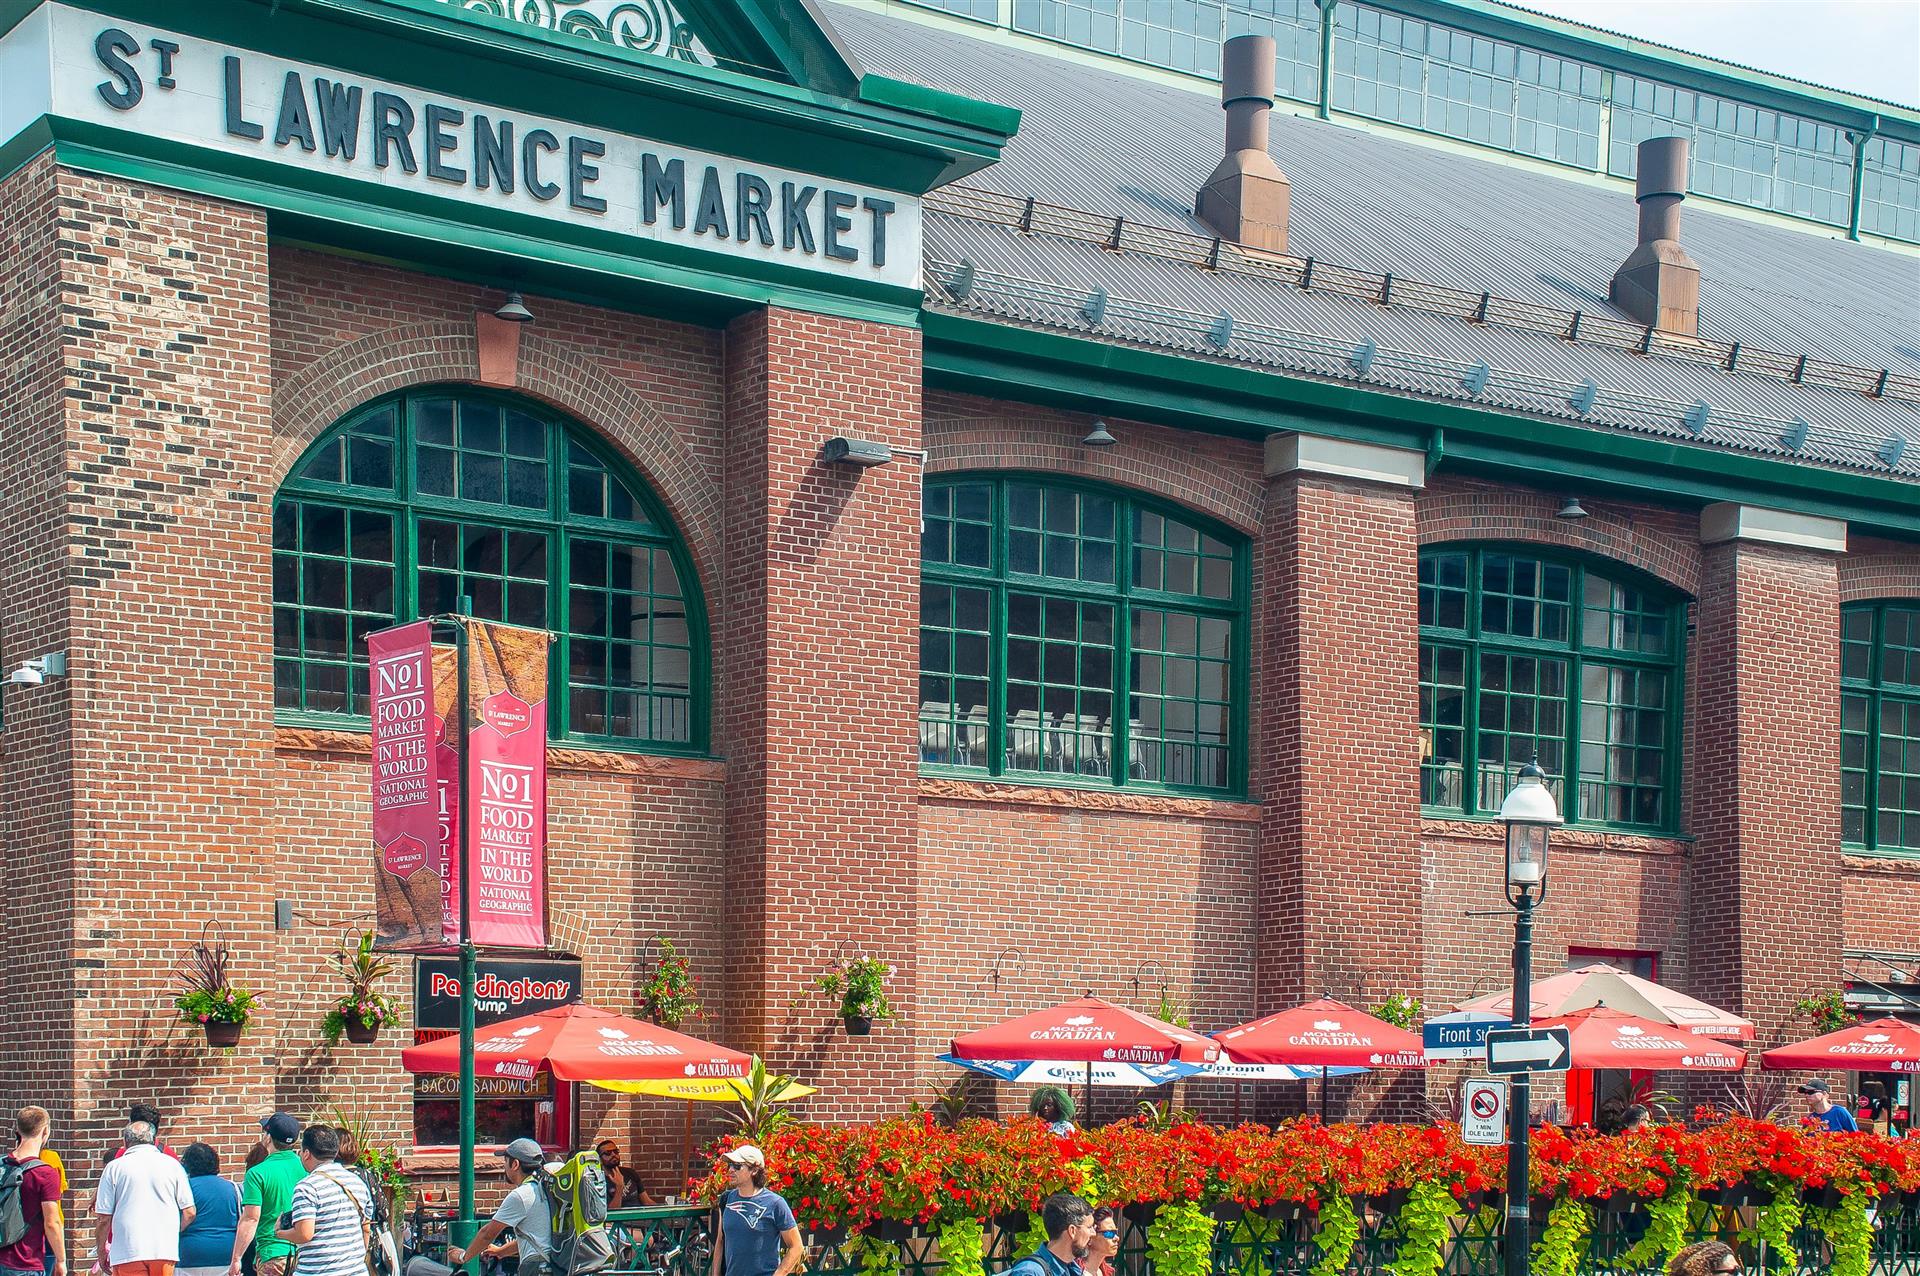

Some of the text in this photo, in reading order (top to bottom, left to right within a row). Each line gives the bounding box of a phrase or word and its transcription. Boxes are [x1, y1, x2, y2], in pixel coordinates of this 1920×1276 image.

[224, 55, 607, 213] LAWRENCE
[642, 152, 897, 268] MARKET
[377, 698, 426, 724] FOOD
[378, 718, 426, 738] MARKET
[378, 739, 427, 762] IN THE
[379, 757, 428, 777] WORLD
[380, 778, 429, 796] NATIONAL
[380, 790, 429, 807] GEOGRAPHIC
[480, 805, 534, 830] FOOD
[480, 827, 533, 845] MARKET
[480, 848, 533, 867] IN THE
[480, 865, 533, 884] WORLD
[480, 886, 533, 901] NATIONAL
[480, 899, 533, 912] GEOGRAPHIC
[431, 972, 571, 1004] Padington's
[1030, 1030, 1117, 1041] CANADIAN
[1288, 1036, 1372, 1046] CANADIAN
[1439, 1026, 1471, 1043] Front
[1475, 1029, 1485, 1042] St
[598, 1045, 684, 1056] CANADIAN
[1610, 1040, 1688, 1049] CANADIAN
[1829, 1046, 1906, 1055] CANADIAN
[1117, 1049, 1165, 1063] CANADIAN
[1384, 1054, 1431, 1066] CANADIAN
[1462, 1048, 1472, 1057] 91
[1694, 1056, 1736, 1068] CANADIAN
[697, 1063, 743, 1077] CANADIAN
[474, 1079, 539, 1093] SANDWICH
[667, 1084, 726, 1094] FINS UP!
